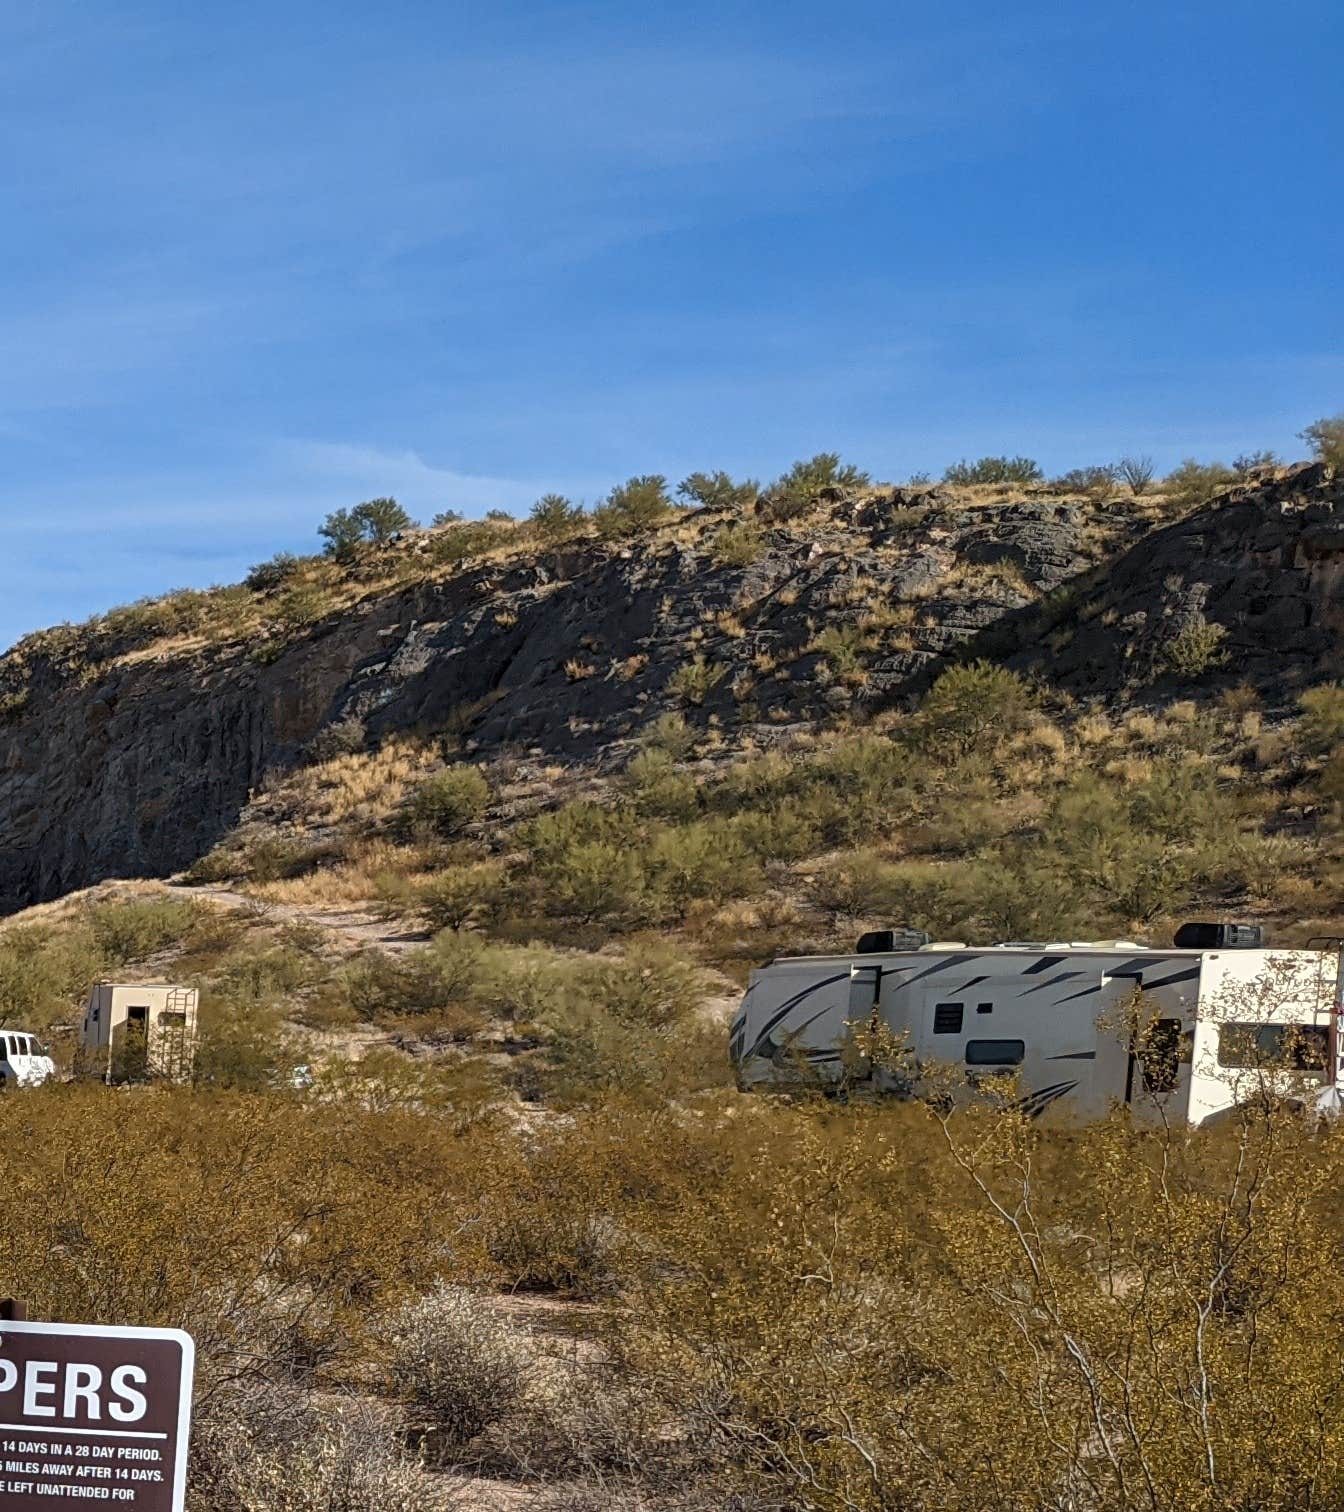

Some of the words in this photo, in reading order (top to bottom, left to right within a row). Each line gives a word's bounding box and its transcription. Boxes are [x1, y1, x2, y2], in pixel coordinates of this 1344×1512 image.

[2, 1440, 16, 1452] 14
[18, 1441, 48, 1455] DAYS
[50, 1443, 63, 1456] IN
[63, 1444, 74, 1456] A
[74, 1445, 90, 1457] 28
[92, 1445, 116, 1459] DAY
[117, 1447, 163, 1462] PERIOD.
[5, 1460, 40, 1474] MILES
[40, 1463, 75, 1477] AWAY
[75, 1465, 112, 1479] AFTER
[114, 1468, 129, 1480] 14
[130, 1468, 165, 1482] DAYS.
[7, 1481, 35, 1494] LEFT
[36, 1483, 110, 1499] UNATTENDED
[111, 1488, 136, 1501] FOR
